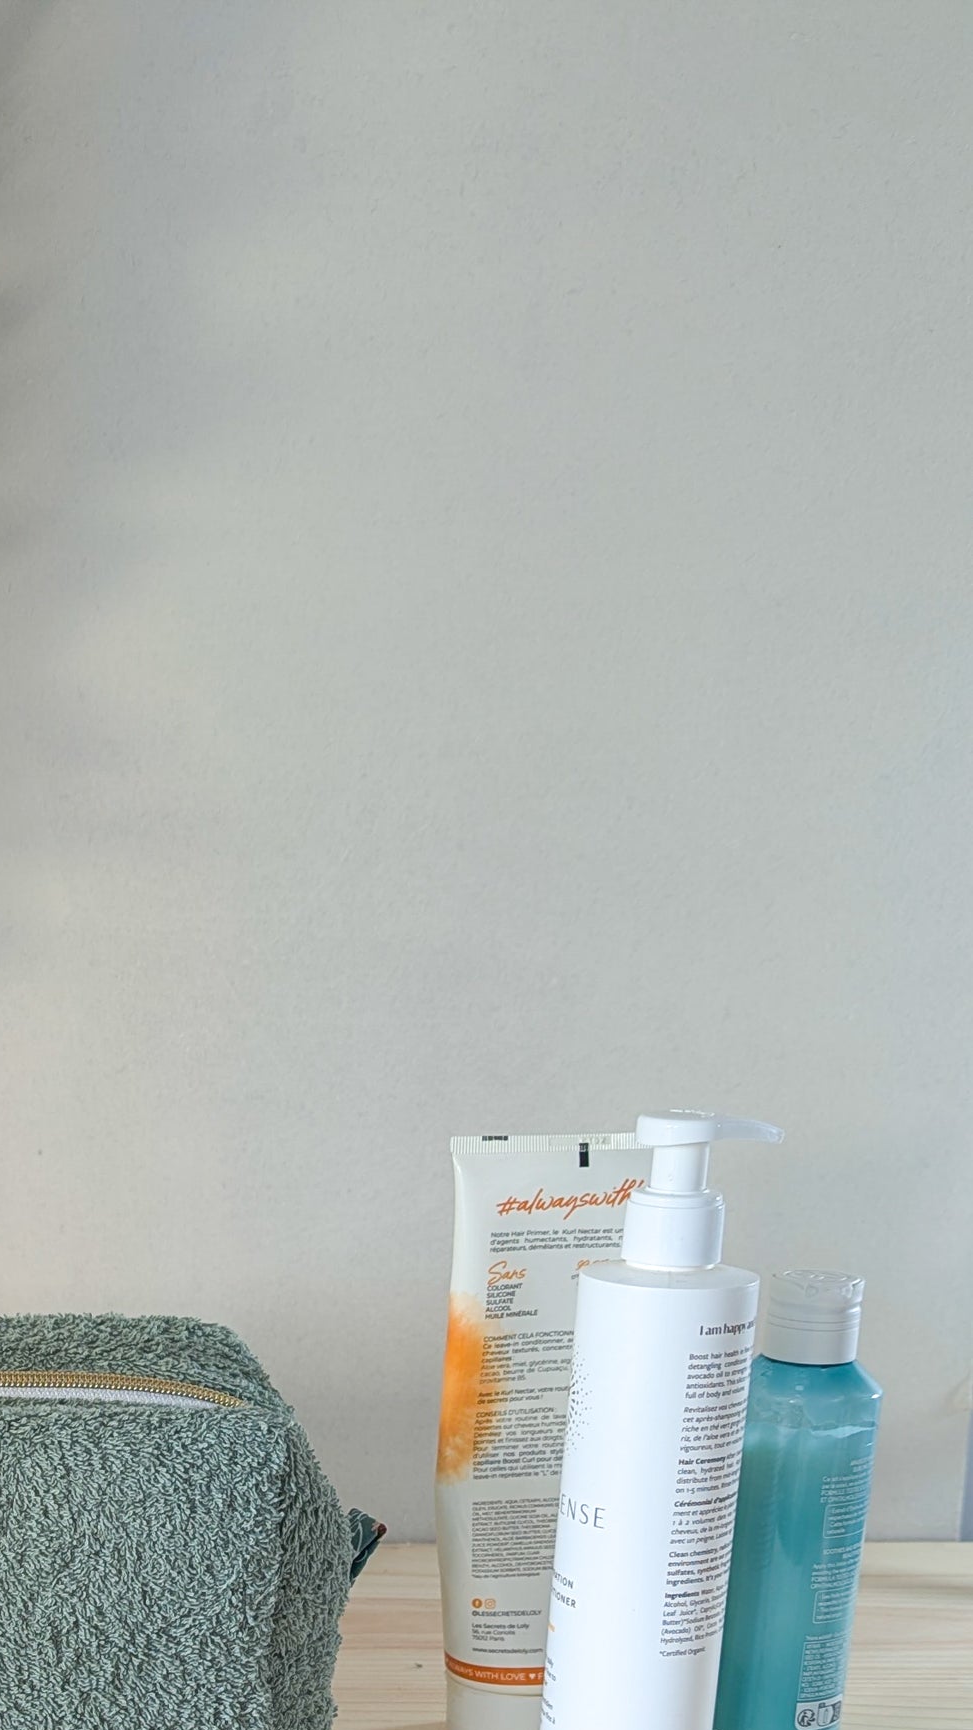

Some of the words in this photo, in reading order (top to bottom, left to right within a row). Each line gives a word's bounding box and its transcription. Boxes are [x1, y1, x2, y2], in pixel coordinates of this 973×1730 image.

[490, 1245, 527, 1253] réparateurs,
[487, 1260, 526, 1285] Sans
[487, 1283, 523, 1291] COLORANT
[485, 1312, 504, 1320] HUILE
[506, 1309, 538, 1318] MINÉRALE
[700, 1326, 703, 1336] I
[705, 1326, 721, 1335] am
[483, 1334, 517, 1342] COMMENT
[688, 1363, 721, 1371] detangling
[487, 1396, 508, 1404] secrets
[476, 1410, 507, 1418] CONSEILS
[514, 1421, 540, 1429] cheveux
[473, 1458, 501, 1466] capillaire
[696, 1456, 726, 1465] Ceremony
[701, 1465, 725, 1475] hydrated
[499, 1471, 532, 1479] représente
[674, 1498, 713, 1507] Cérémonial
[668, 1558, 709, 1567] environment
[666, 1578, 704, 1587] ingredients.
[665, 1592, 699, 1600] Ingredients
[475, 1670, 499, 1680] WITH
[501, 1672, 526, 1681] LOVE
